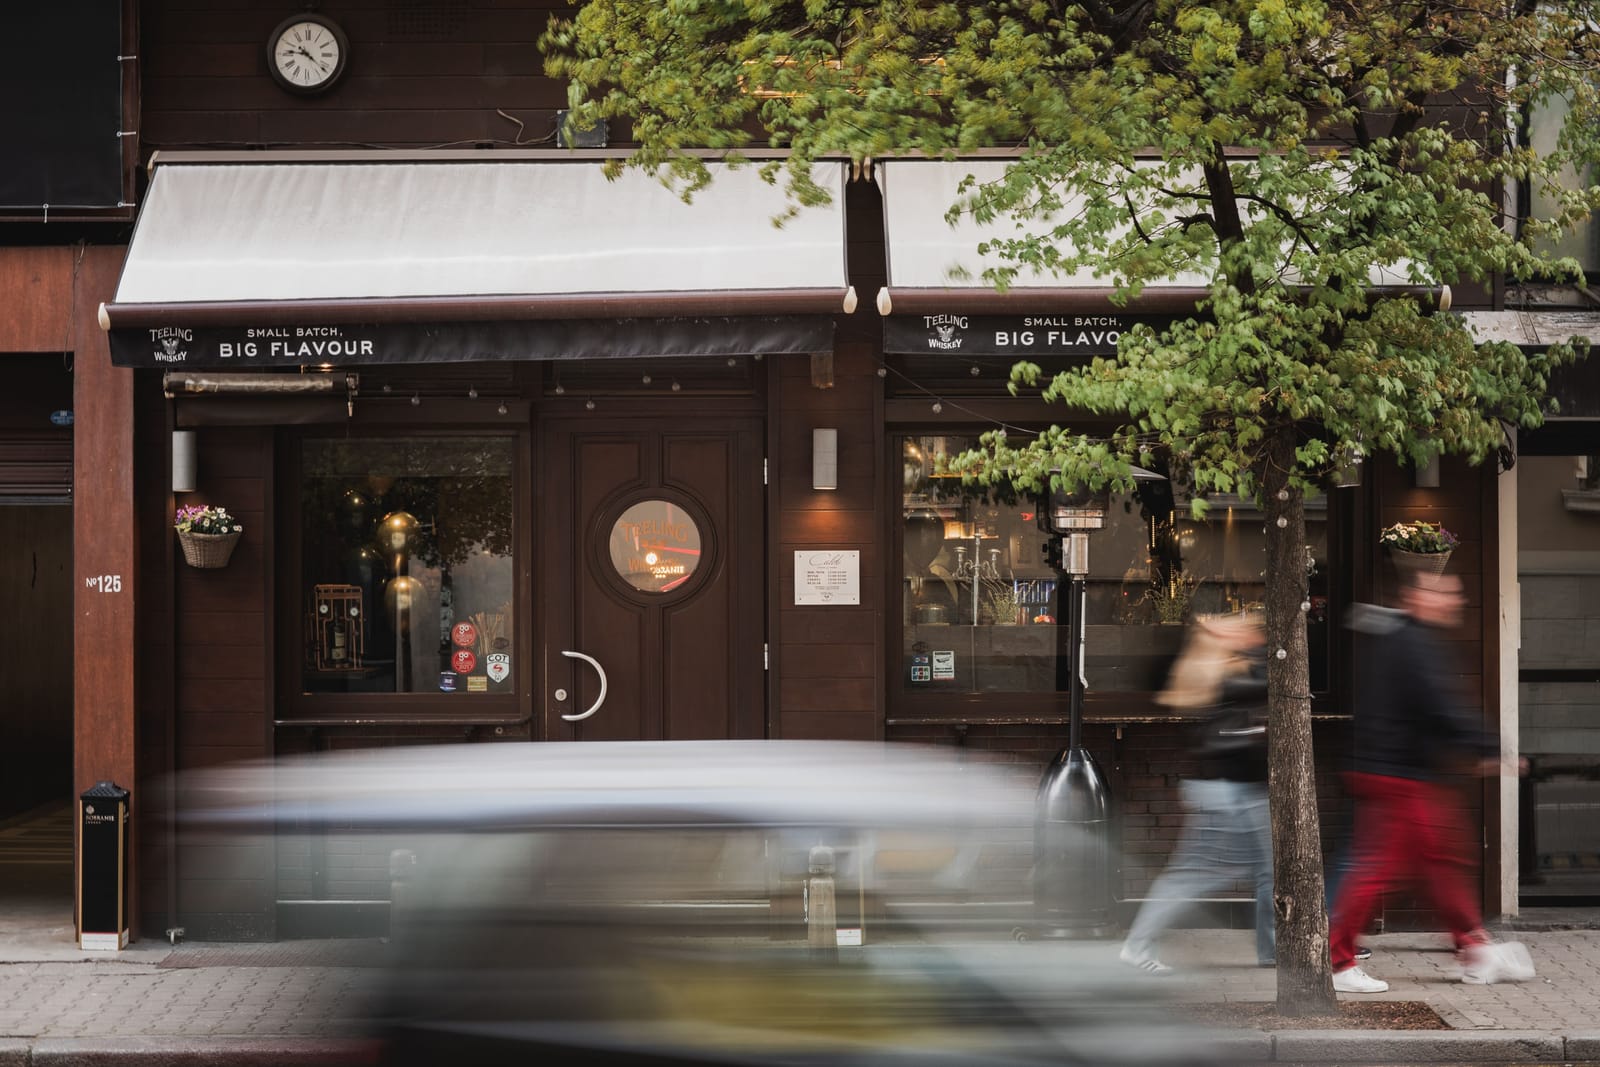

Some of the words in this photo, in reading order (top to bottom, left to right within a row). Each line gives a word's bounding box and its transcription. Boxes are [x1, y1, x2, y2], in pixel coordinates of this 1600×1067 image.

[923, 314, 969, 330] TEELING
[1023, 317, 1068, 327] SMALL
[1074, 317, 1123, 328] BATCH,
[149, 327, 193, 343] TEELING
[247, 328, 290, 338] SMALL
[296, 327, 343, 337] BATCH,
[995, 331, 1035, 347] BIG
[1047, 331, 1151, 346] FLAVO
[219, 343, 258, 358] BIG
[270, 340, 374, 357] FLAVOUR
[928, 338, 963, 350] WHISKEY
[153, 351, 188, 363] WHISKEY
